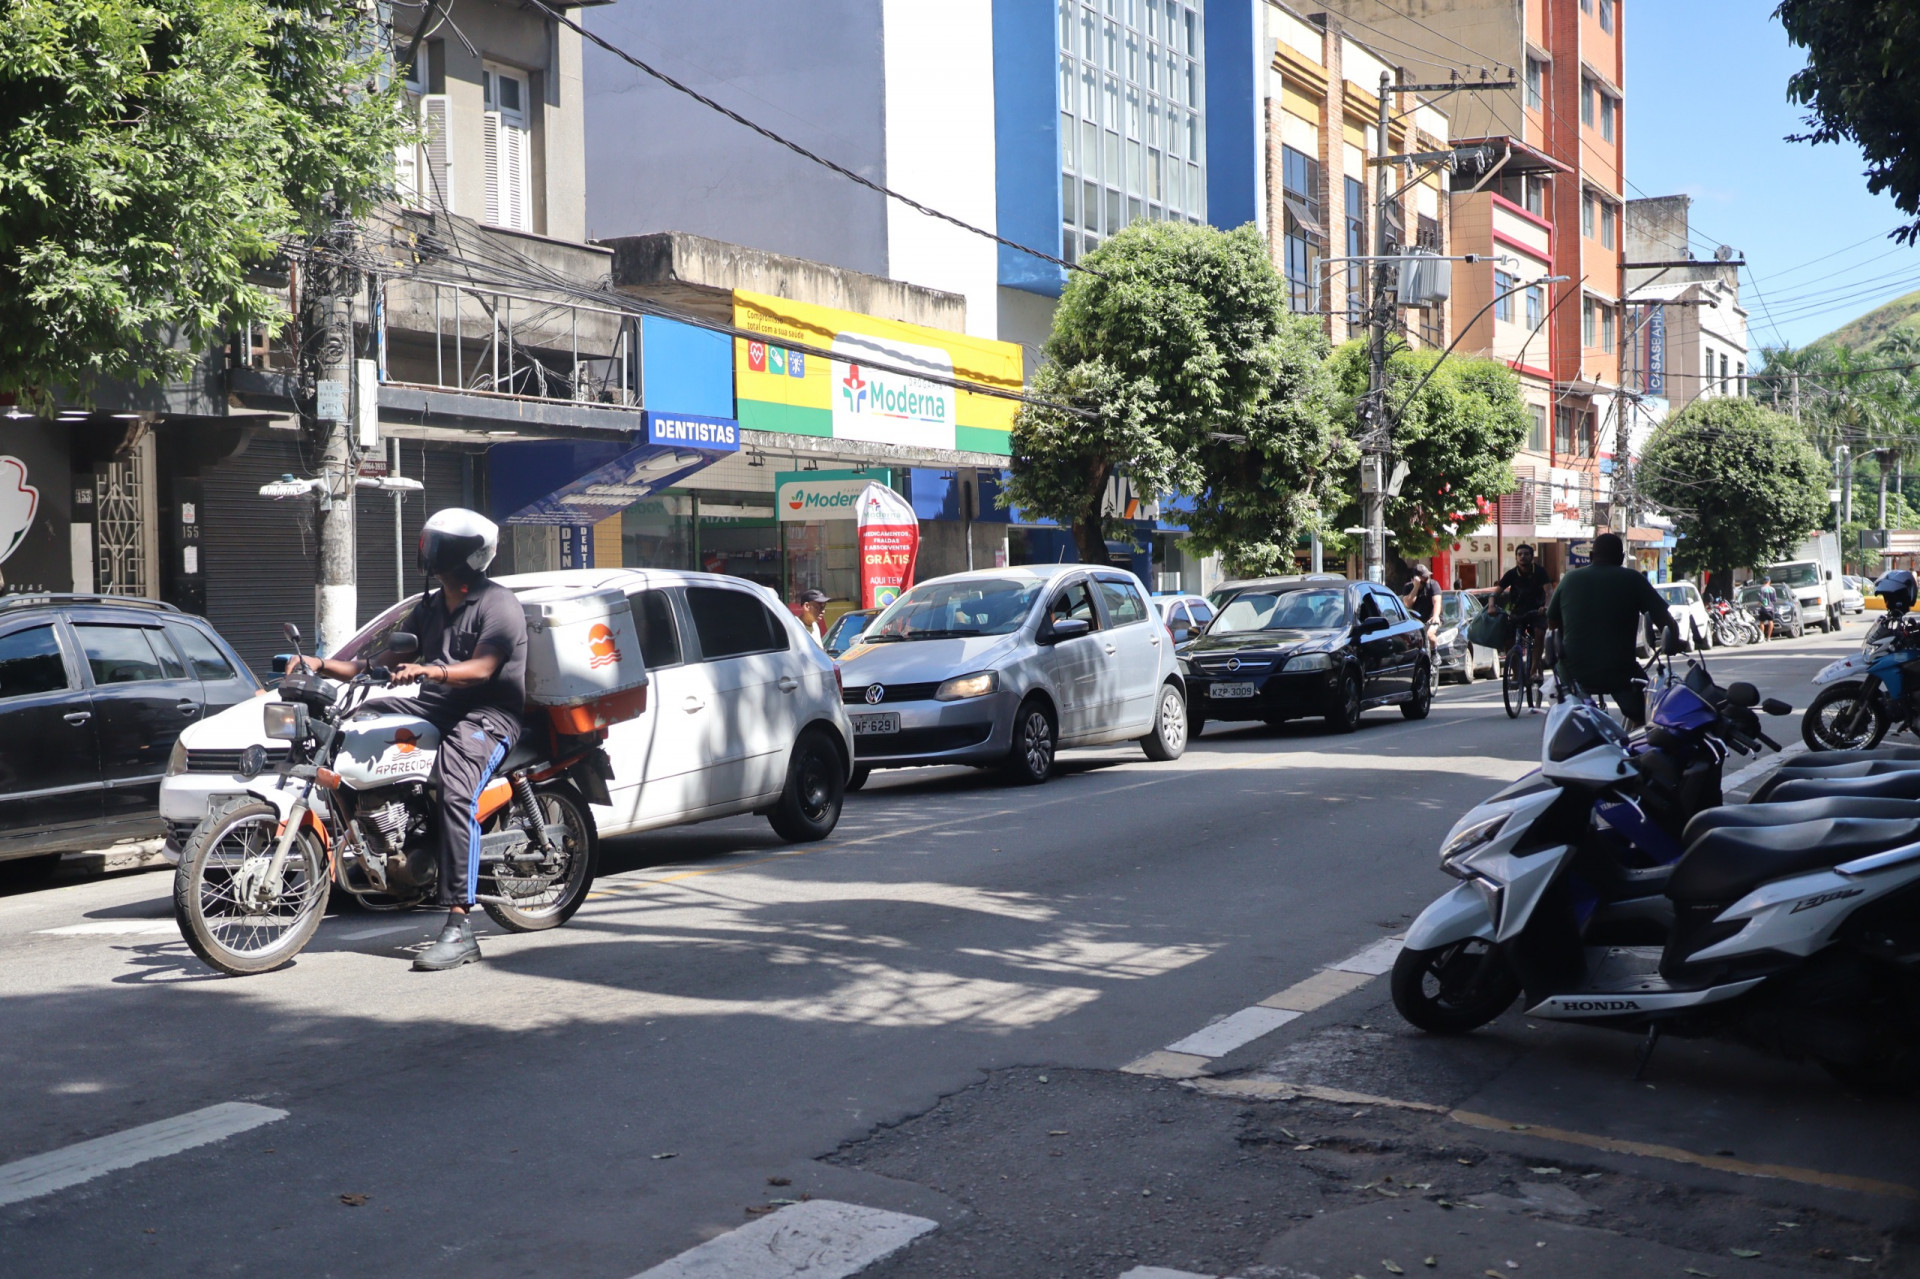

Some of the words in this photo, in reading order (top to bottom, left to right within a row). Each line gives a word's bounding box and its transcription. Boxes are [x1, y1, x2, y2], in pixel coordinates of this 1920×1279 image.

[747, 321, 761, 331] total
[761, 325, 773, 333] com
[778, 328, 788, 337] sua
[870, 380, 945, 418] Moderna
[655, 419, 735, 444] DENTISTAS
[182, 526, 199, 538] 155
[865, 551, 910, 565] GRÁTIS
[375, 759, 434, 775] APARECIDA
[1562, 1001, 1642, 1011] HONDA
